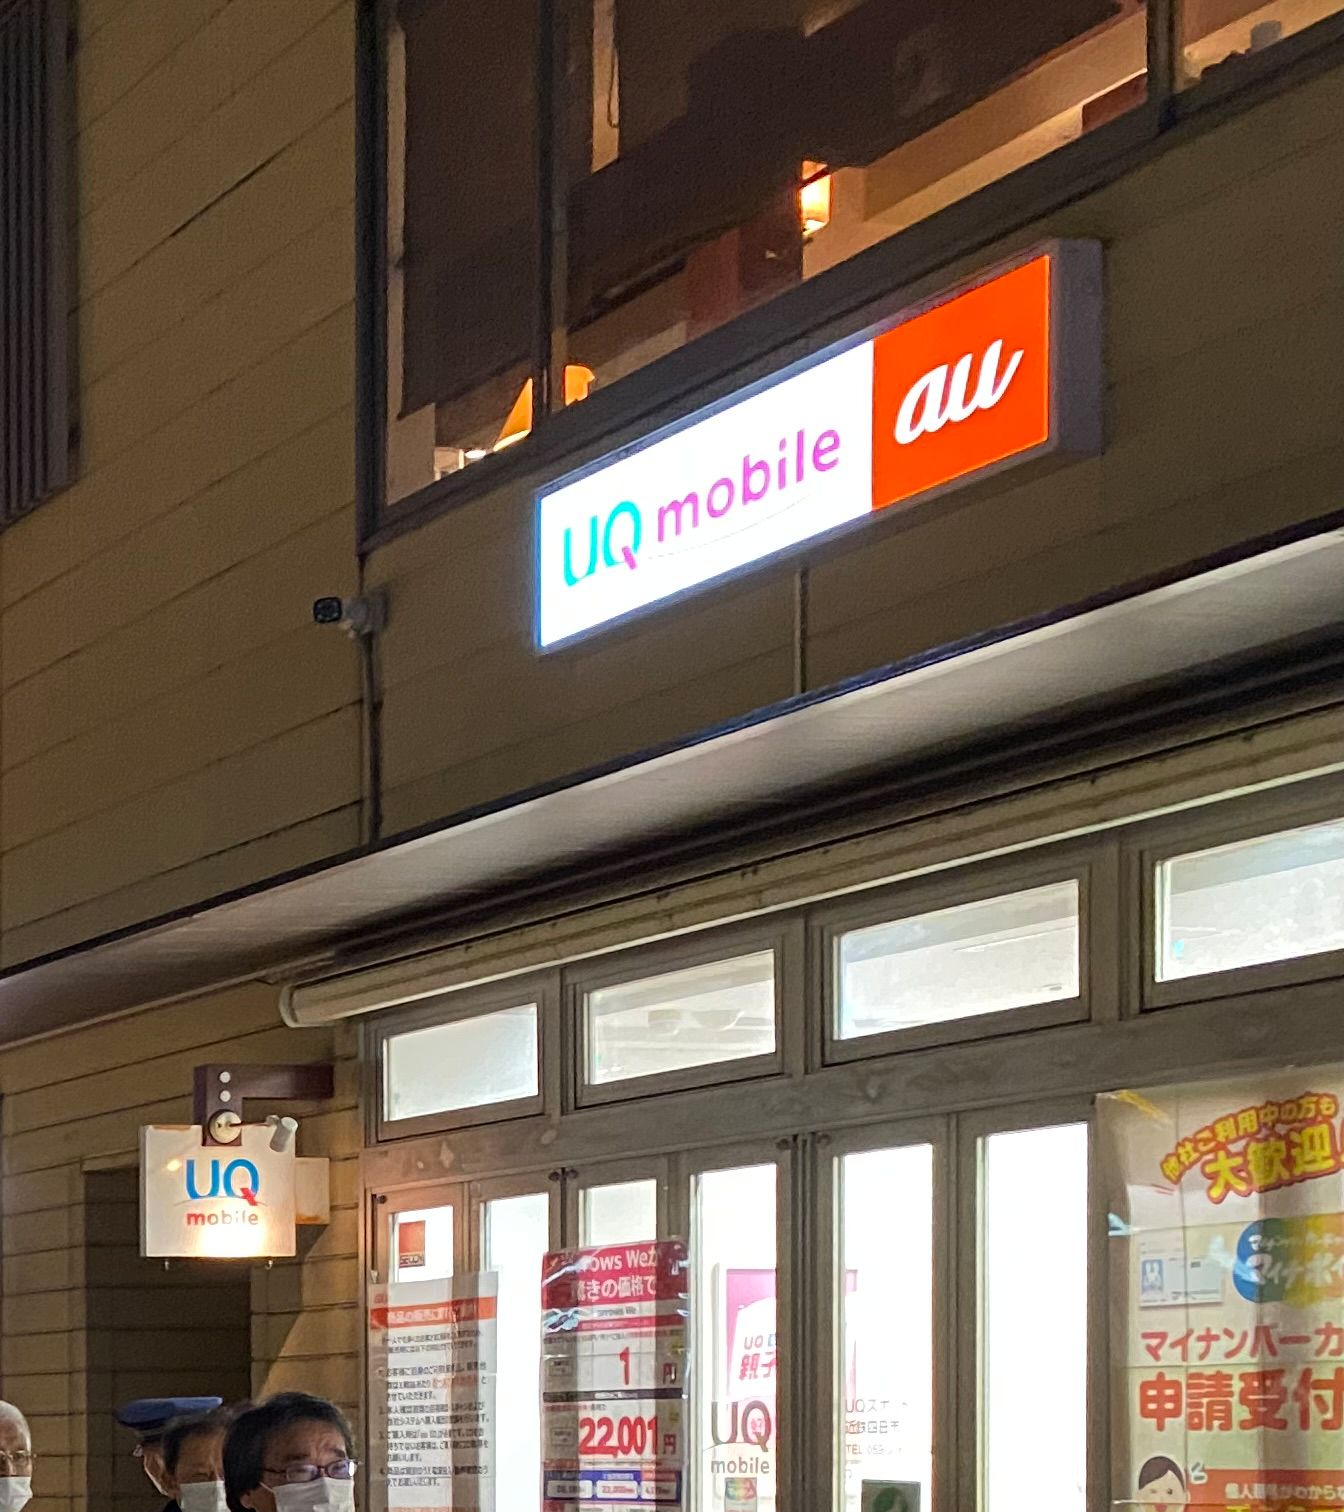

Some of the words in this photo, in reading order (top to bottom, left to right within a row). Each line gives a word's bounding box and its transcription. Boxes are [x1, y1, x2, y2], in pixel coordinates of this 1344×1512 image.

[895, 339, 1024, 444] au
[563, 501, 641, 586] UQ
[657, 428, 841, 542] mobile
[185, 1158, 260, 1206] UQ
[186, 1210, 259, 1227] mobile
[578, 1415, 658, 1458] 22,001
[711, 1400, 772, 1453] UQ
[710, 1456, 770, 1475] mobile
